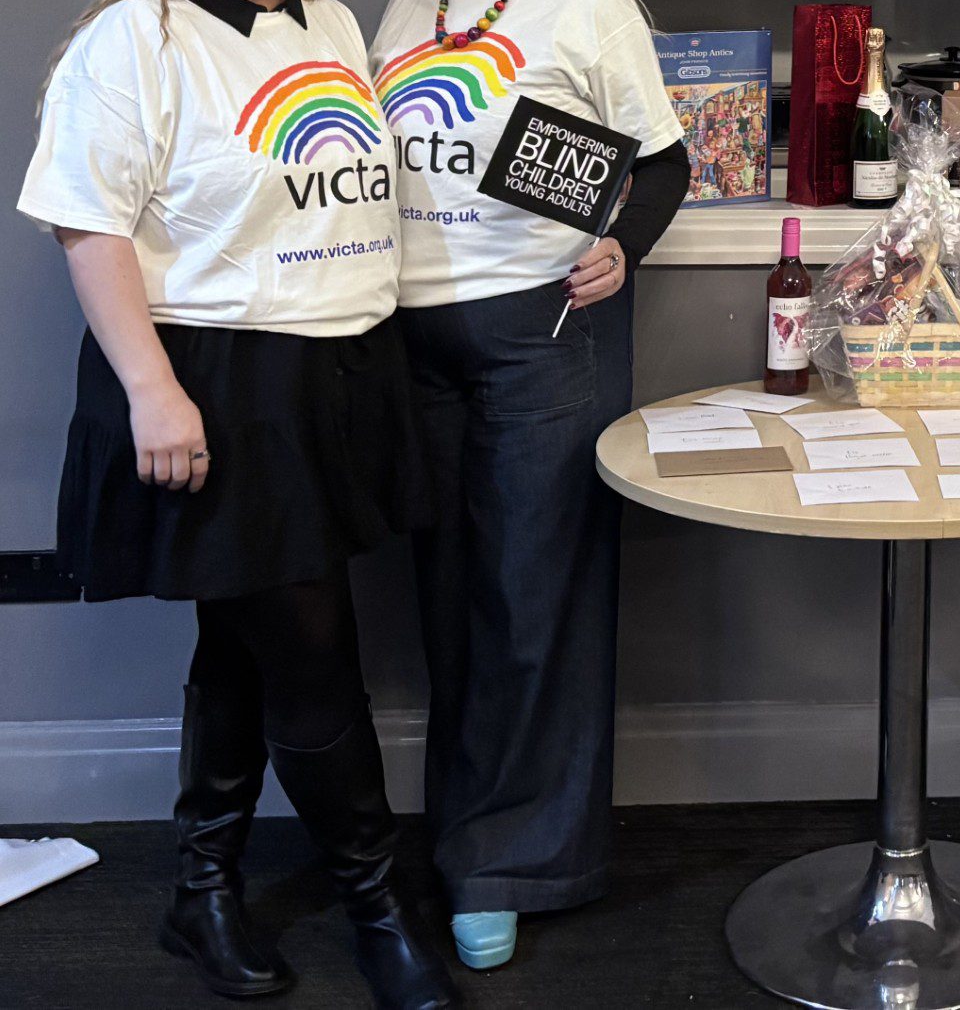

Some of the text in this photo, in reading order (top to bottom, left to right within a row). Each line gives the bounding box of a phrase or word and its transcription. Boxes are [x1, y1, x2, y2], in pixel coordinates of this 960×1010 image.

[687, 50, 708, 58] Shop
[709, 49, 734, 57] Antics
[393, 130, 476, 175] icta
[515, 131, 610, 185] BLIND
[527, 117, 619, 161] EMPOWERING
[283, 158, 391, 210] victa
[505, 175, 593, 218] YOUNG ADULTS
[508, 160, 601, 206] CHILDREN
[398, 205, 481, 225] icta.org.uk
[276, 235, 395, 264] www.victa.org.uk
